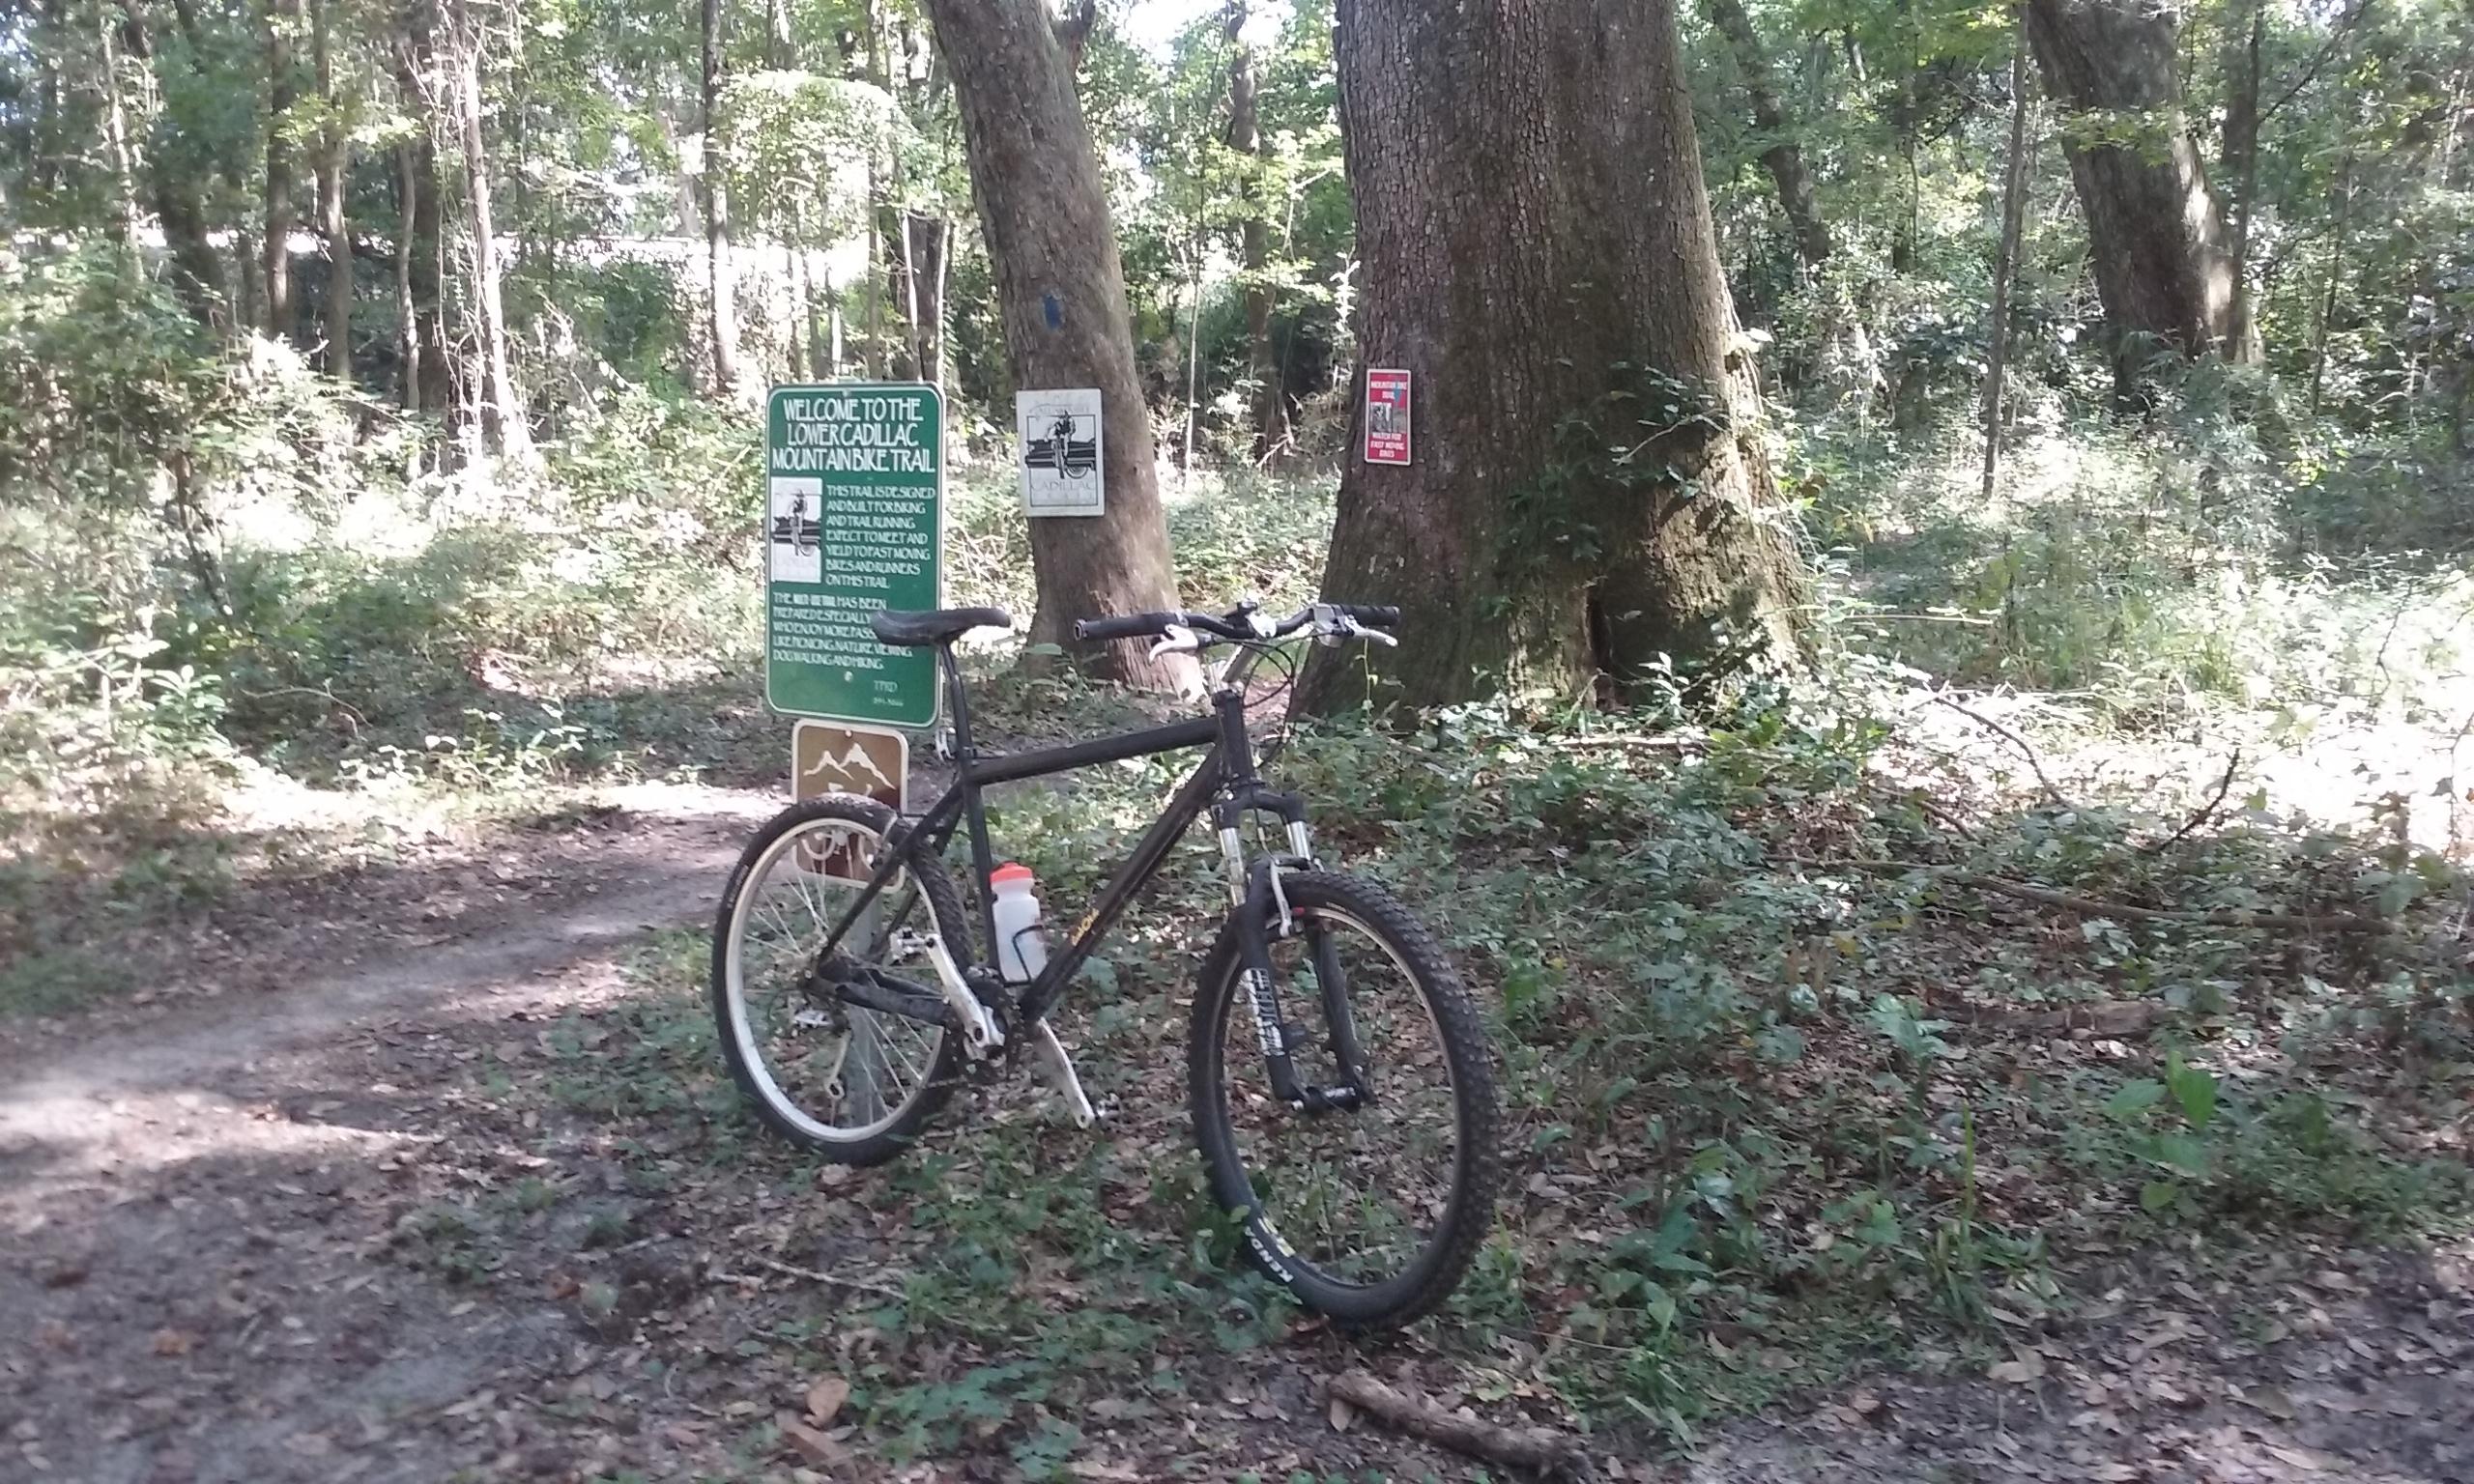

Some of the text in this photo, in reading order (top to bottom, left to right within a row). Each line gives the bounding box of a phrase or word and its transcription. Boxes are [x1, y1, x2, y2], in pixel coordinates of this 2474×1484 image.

[783, 397, 924, 421] WELCOME TO THE
[788, 423, 919, 446] LOWER CADILLAC
[772, 447, 935, 473] MOUNTAIN BIKE TRAIL
[826, 484, 935, 499] THIS TRAIL IS DESIGNED
[826, 499, 926, 514] AND BUILT FOR BIKING
[826, 515, 916, 529] AND TRAIL RUNNING
[826, 528, 928, 545] EXPECT TO MEET AND
[826, 544, 931, 560] YIELD TO FAST MOVING
[826, 558, 921, 575] BIKES AND RUNNERS
[826, 573, 841, 585] ON
[840, 574, 863, 586] THIS
[773, 592, 792, 604] THE
[836, 596, 858, 609] HAS
[858, 597, 887, 611] BEEN
[773, 635, 792, 647] LIKE
[773, 648, 793, 662] DOG
[1245, 1226, 1294, 1283] KENDA
